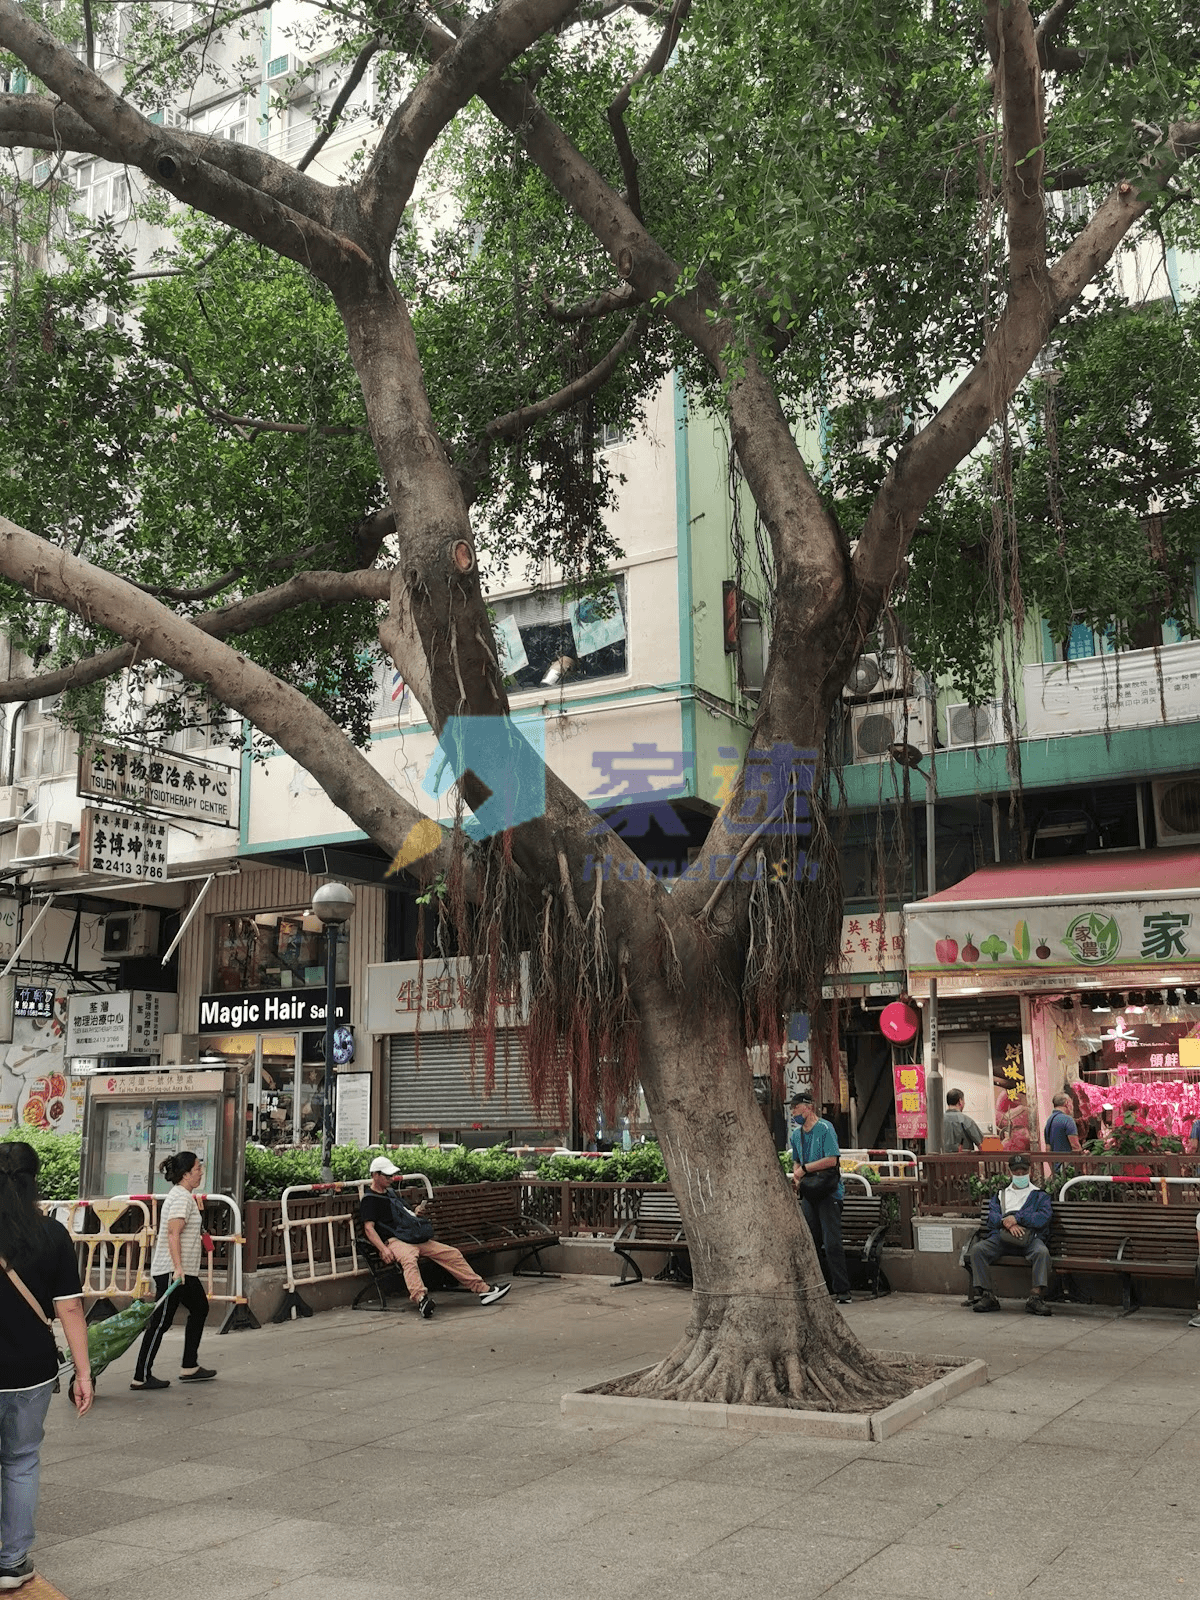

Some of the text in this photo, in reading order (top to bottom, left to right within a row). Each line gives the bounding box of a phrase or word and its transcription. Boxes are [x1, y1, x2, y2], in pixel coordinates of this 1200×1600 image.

[92, 748, 227, 797] 荃灣物理治療中心
[91, 775, 227, 815] TSUEN WAN PHYSIOTHERAPY CENTRE
[93, 829, 142, 860] 李博坤
[106, 859, 163, 878] 2413 3786
[1140, 911, 1192, 960] 家
[73, 1013, 124, 1027] 物理治療中心
[89, 1001, 109, 1013] 荃灣
[201, 996, 343, 1028] Magic Hair Saln
